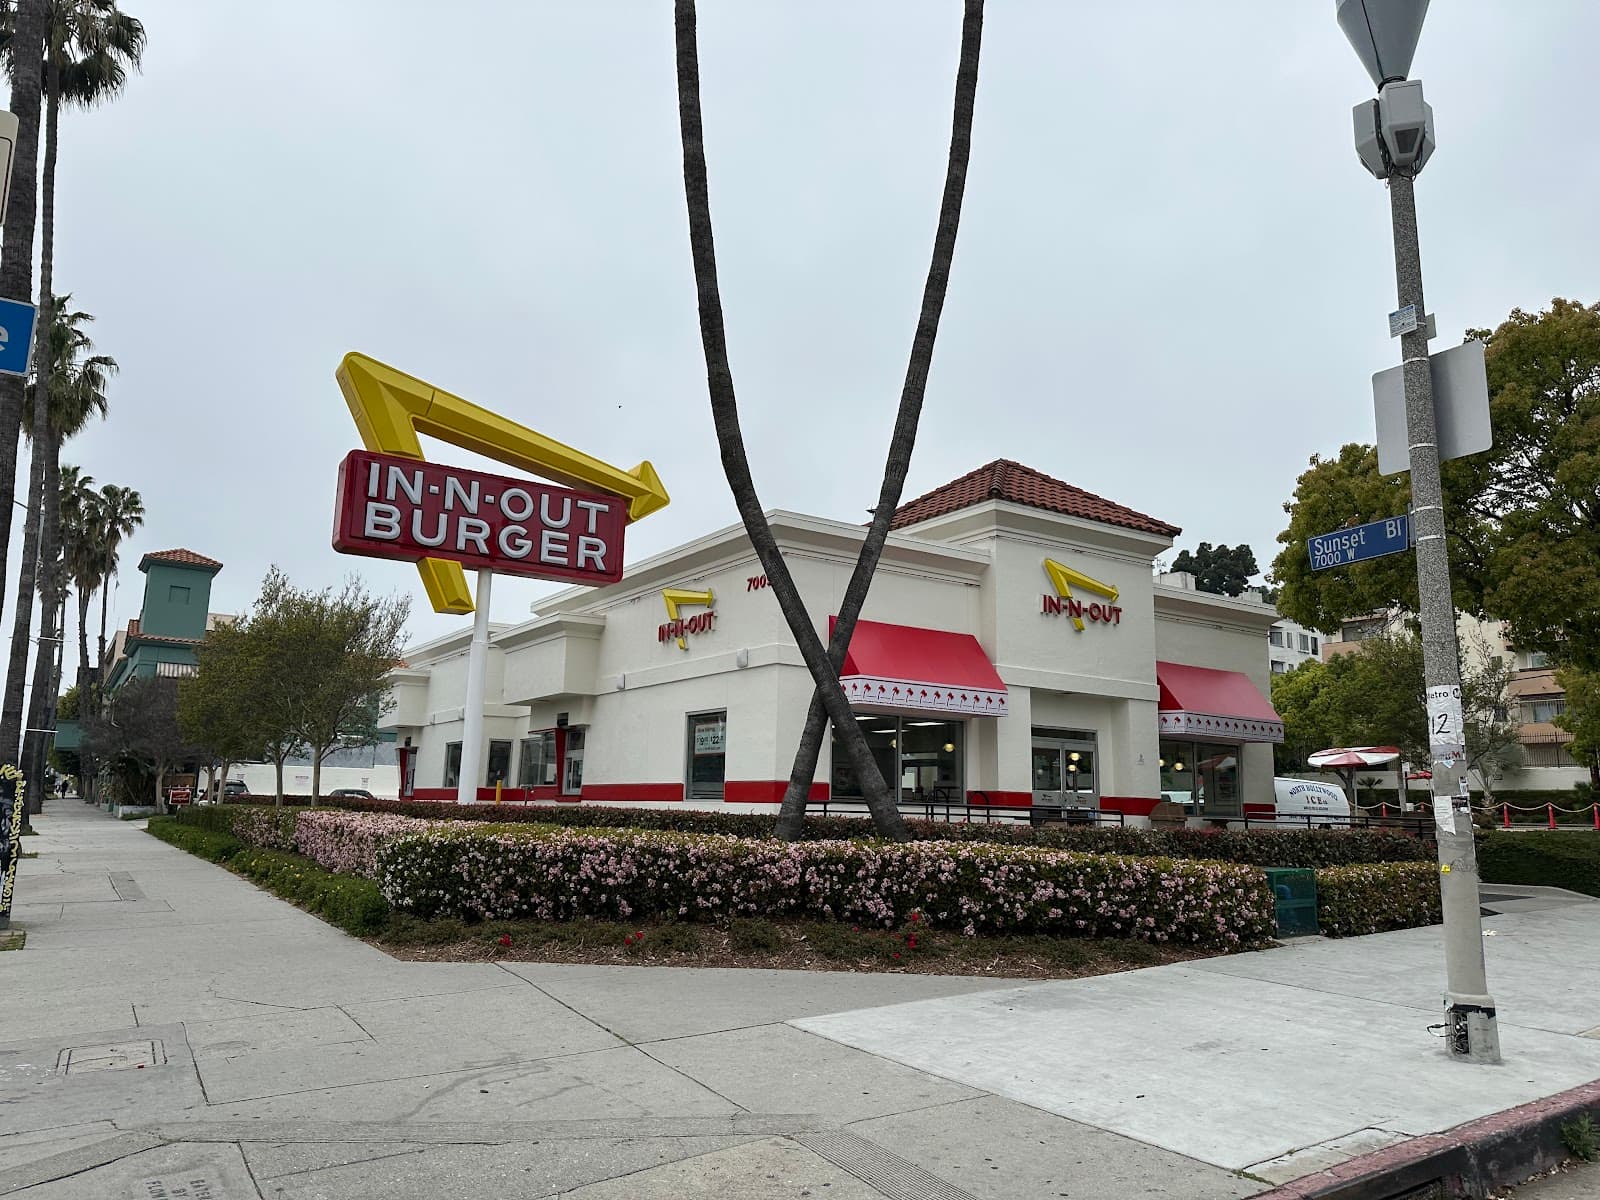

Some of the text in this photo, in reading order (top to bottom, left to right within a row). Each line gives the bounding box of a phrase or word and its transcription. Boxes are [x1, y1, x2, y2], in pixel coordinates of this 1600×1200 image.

[363, 501, 608, 571] BURGER
[1314, 528, 1366, 556] Sunset
[1314, 547, 1355, 567] 7000 W
[747, 575, 772, 592] 700
[1042, 594, 1123, 625] IN-N-OUT
[658, 611, 714, 642] IN-N-OUT
[1427, 691, 1449, 699] etro
[1431, 713, 1451, 735] 12
[1289, 784, 1338, 801] NORTH HOLLYWOOD
[1306, 795, 1322, 805] ICE
